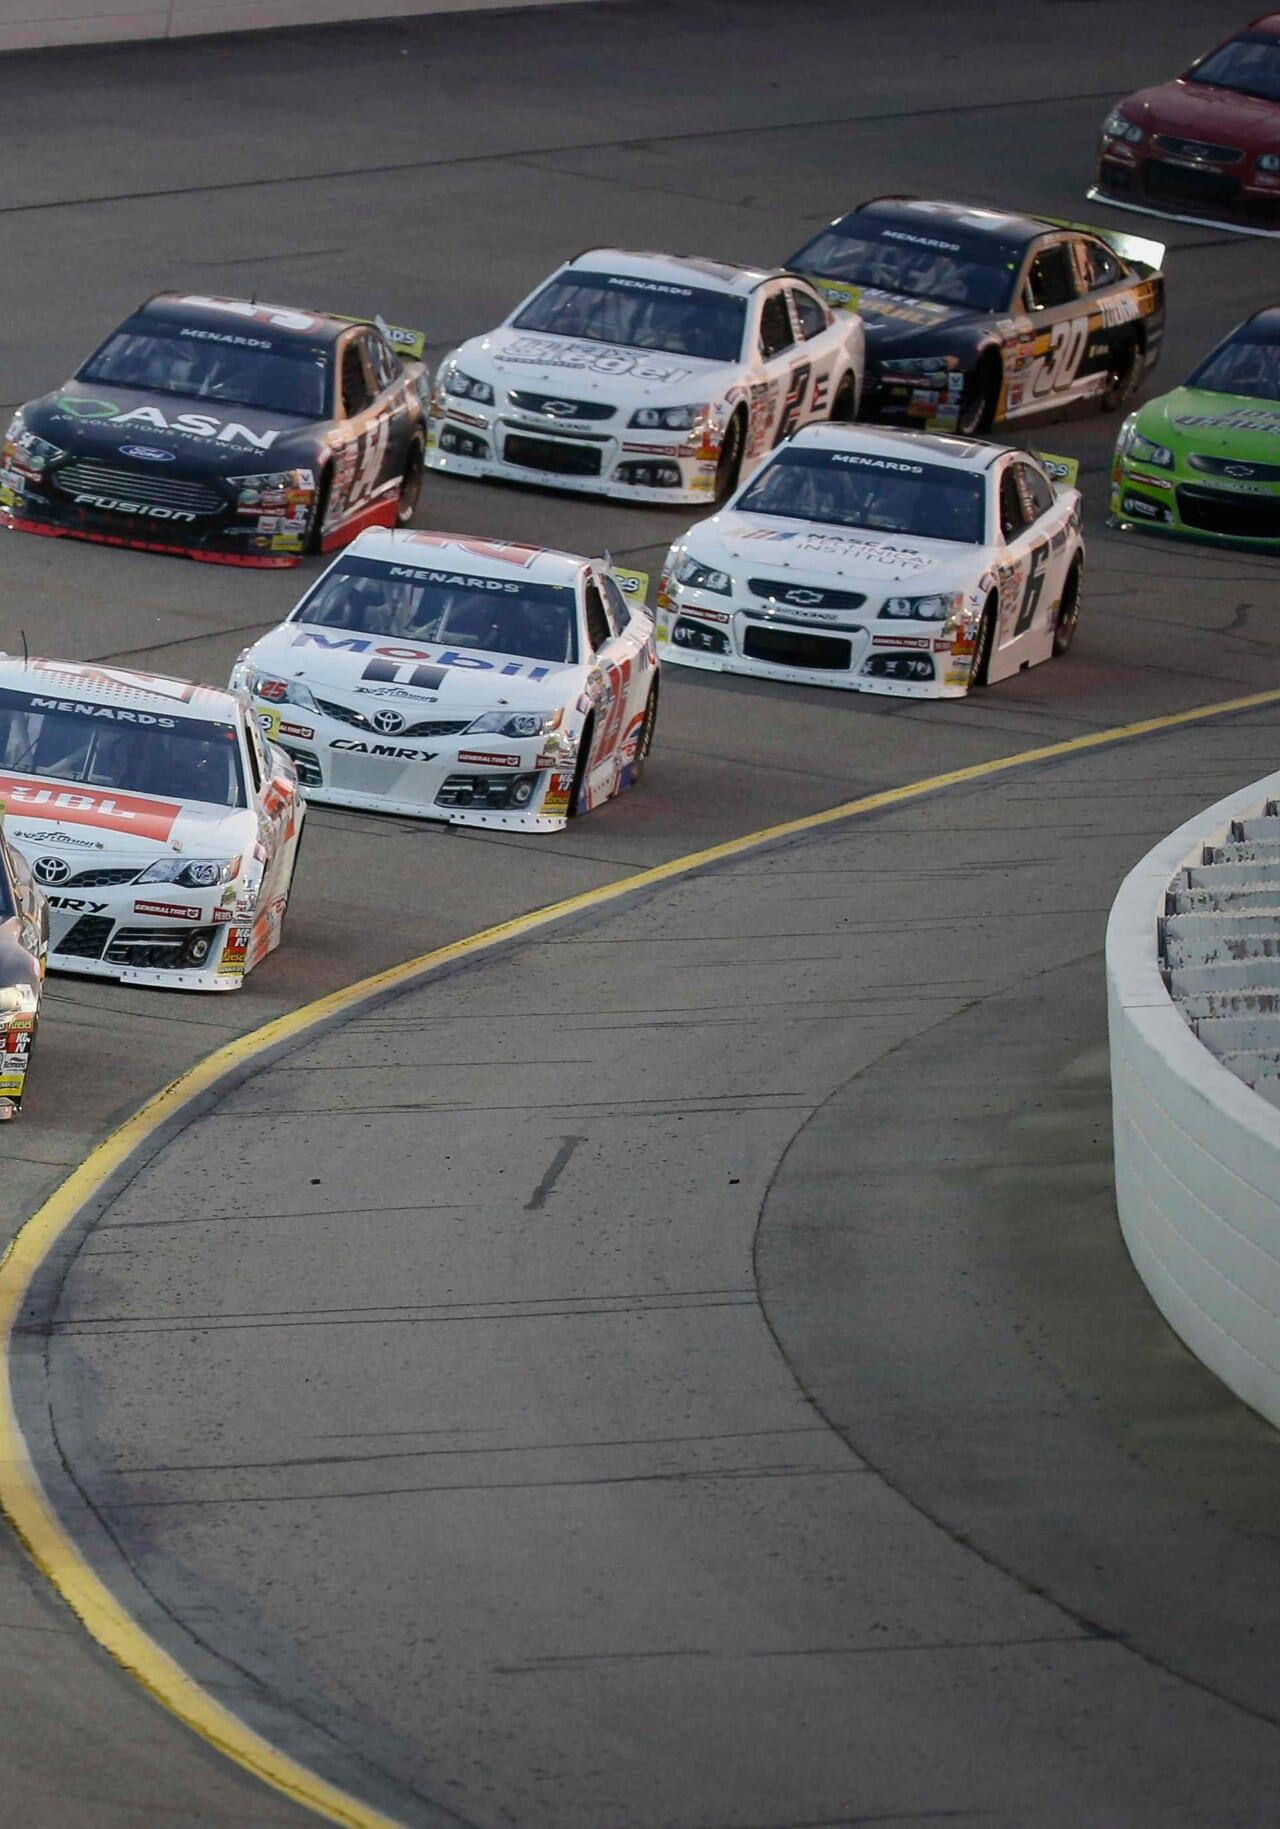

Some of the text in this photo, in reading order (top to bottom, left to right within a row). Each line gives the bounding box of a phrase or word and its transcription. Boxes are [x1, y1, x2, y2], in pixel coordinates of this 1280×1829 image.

[881, 230, 960, 251] MENARDS
[609, 277, 692, 296] MENARDS
[180, 327, 272, 349] MENARDS
[108, 406, 281, 450] ASN
[180, 432, 266, 456] NETWORK
[832, 454, 923, 474] MENARDS
[73, 494, 197, 522] FUSION
[807, 533, 920, 555] NASCAR
[389, 567, 520, 593] MENARDS
[291, 633, 550, 682] Mobil
[30, 697, 177, 730] MENARDS
[328, 738, 439, 761] CAMRY
[8, 785, 137, 819] JBL
[45, 894, 110, 913] MRY
[135, 903, 188, 917] GENERAL TIRE
